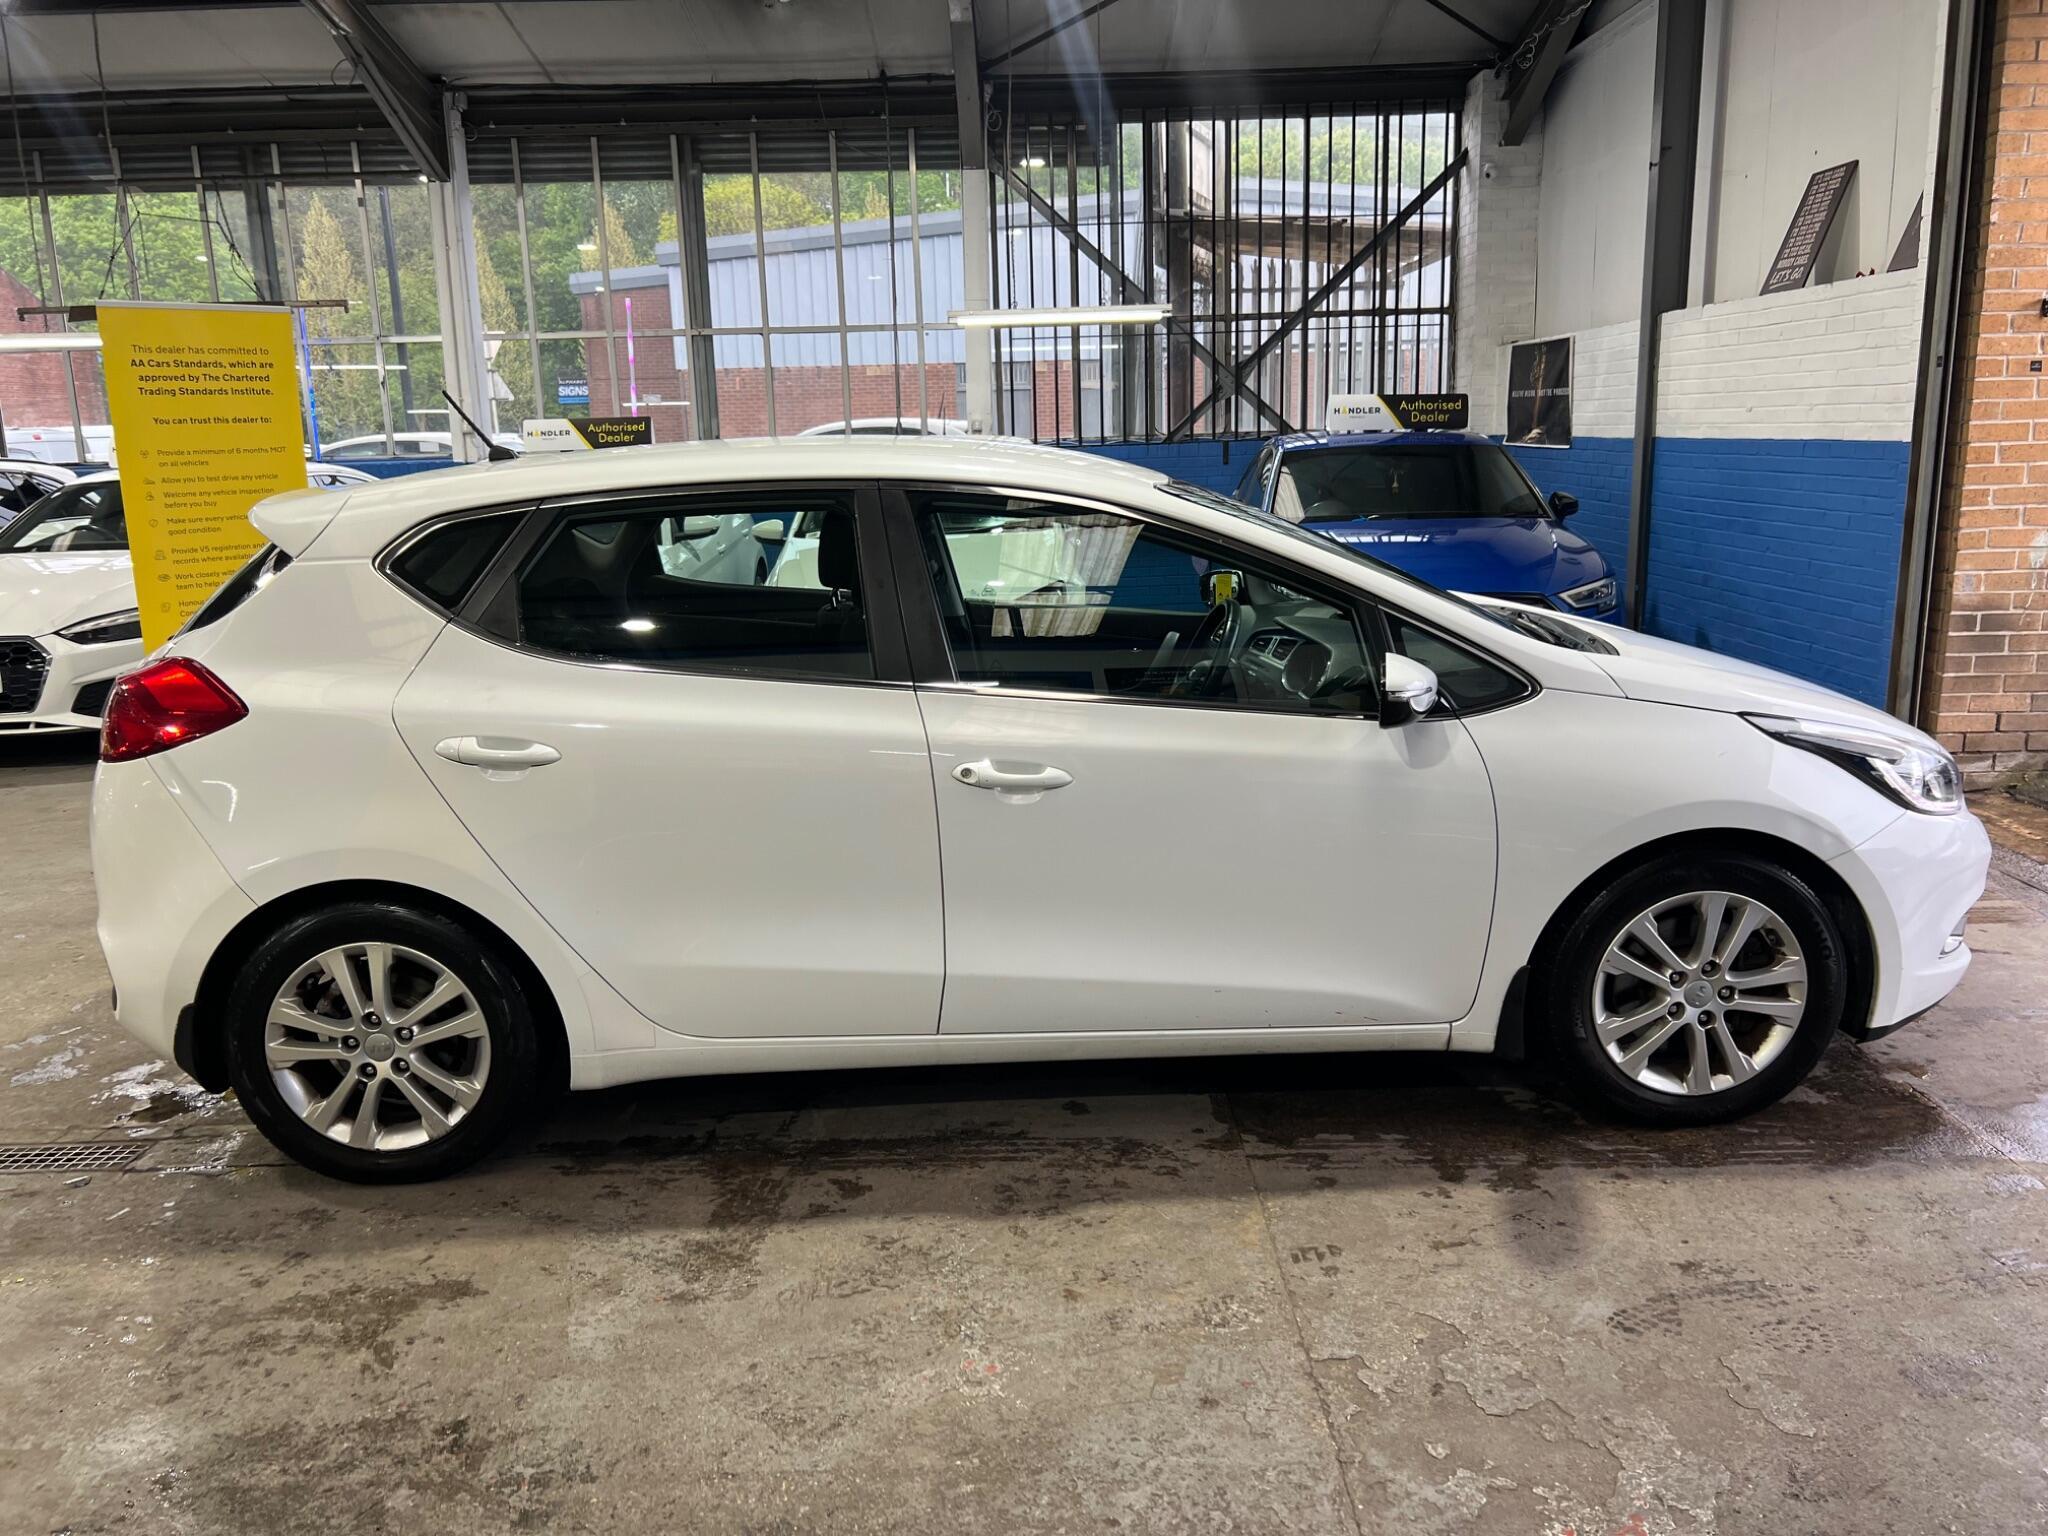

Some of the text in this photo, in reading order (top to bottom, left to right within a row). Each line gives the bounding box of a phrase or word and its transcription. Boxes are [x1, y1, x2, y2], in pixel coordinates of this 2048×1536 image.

[131, 344, 269, 356] This dealer has committed to
[130, 359, 145, 367] AA
[148, 359, 171, 368] Cars
[173, 359, 226, 370] Standards,
[228, 360, 257, 368] which
[138, 374, 270, 384] approved by The Chartered
[138, 387, 274, 397] Trading Standards Institute.
[558, 386, 589, 396] SIGNS
[1400, 400, 1462, 410] Authorised
[214, 416, 230, 424] this
[232, 416, 258, 424] dealer
[260, 416, 272, 424] to:
[1411, 412, 1450, 422] Dealer
[588, 422, 645, 432] Authorised
[598, 432, 634, 442] Dealer
[192, 448, 226, 456] minimum
[270, 446, 286, 454] MOT
[239, 488, 274, 496] inspection
[204, 500, 217, 508] buy
[205, 516, 224, 524] every
[168, 526, 222, 536] good condition
[171, 546, 199, 554] Provide
[212, 544, 252, 553] registration
[196, 570, 220, 579] closely
